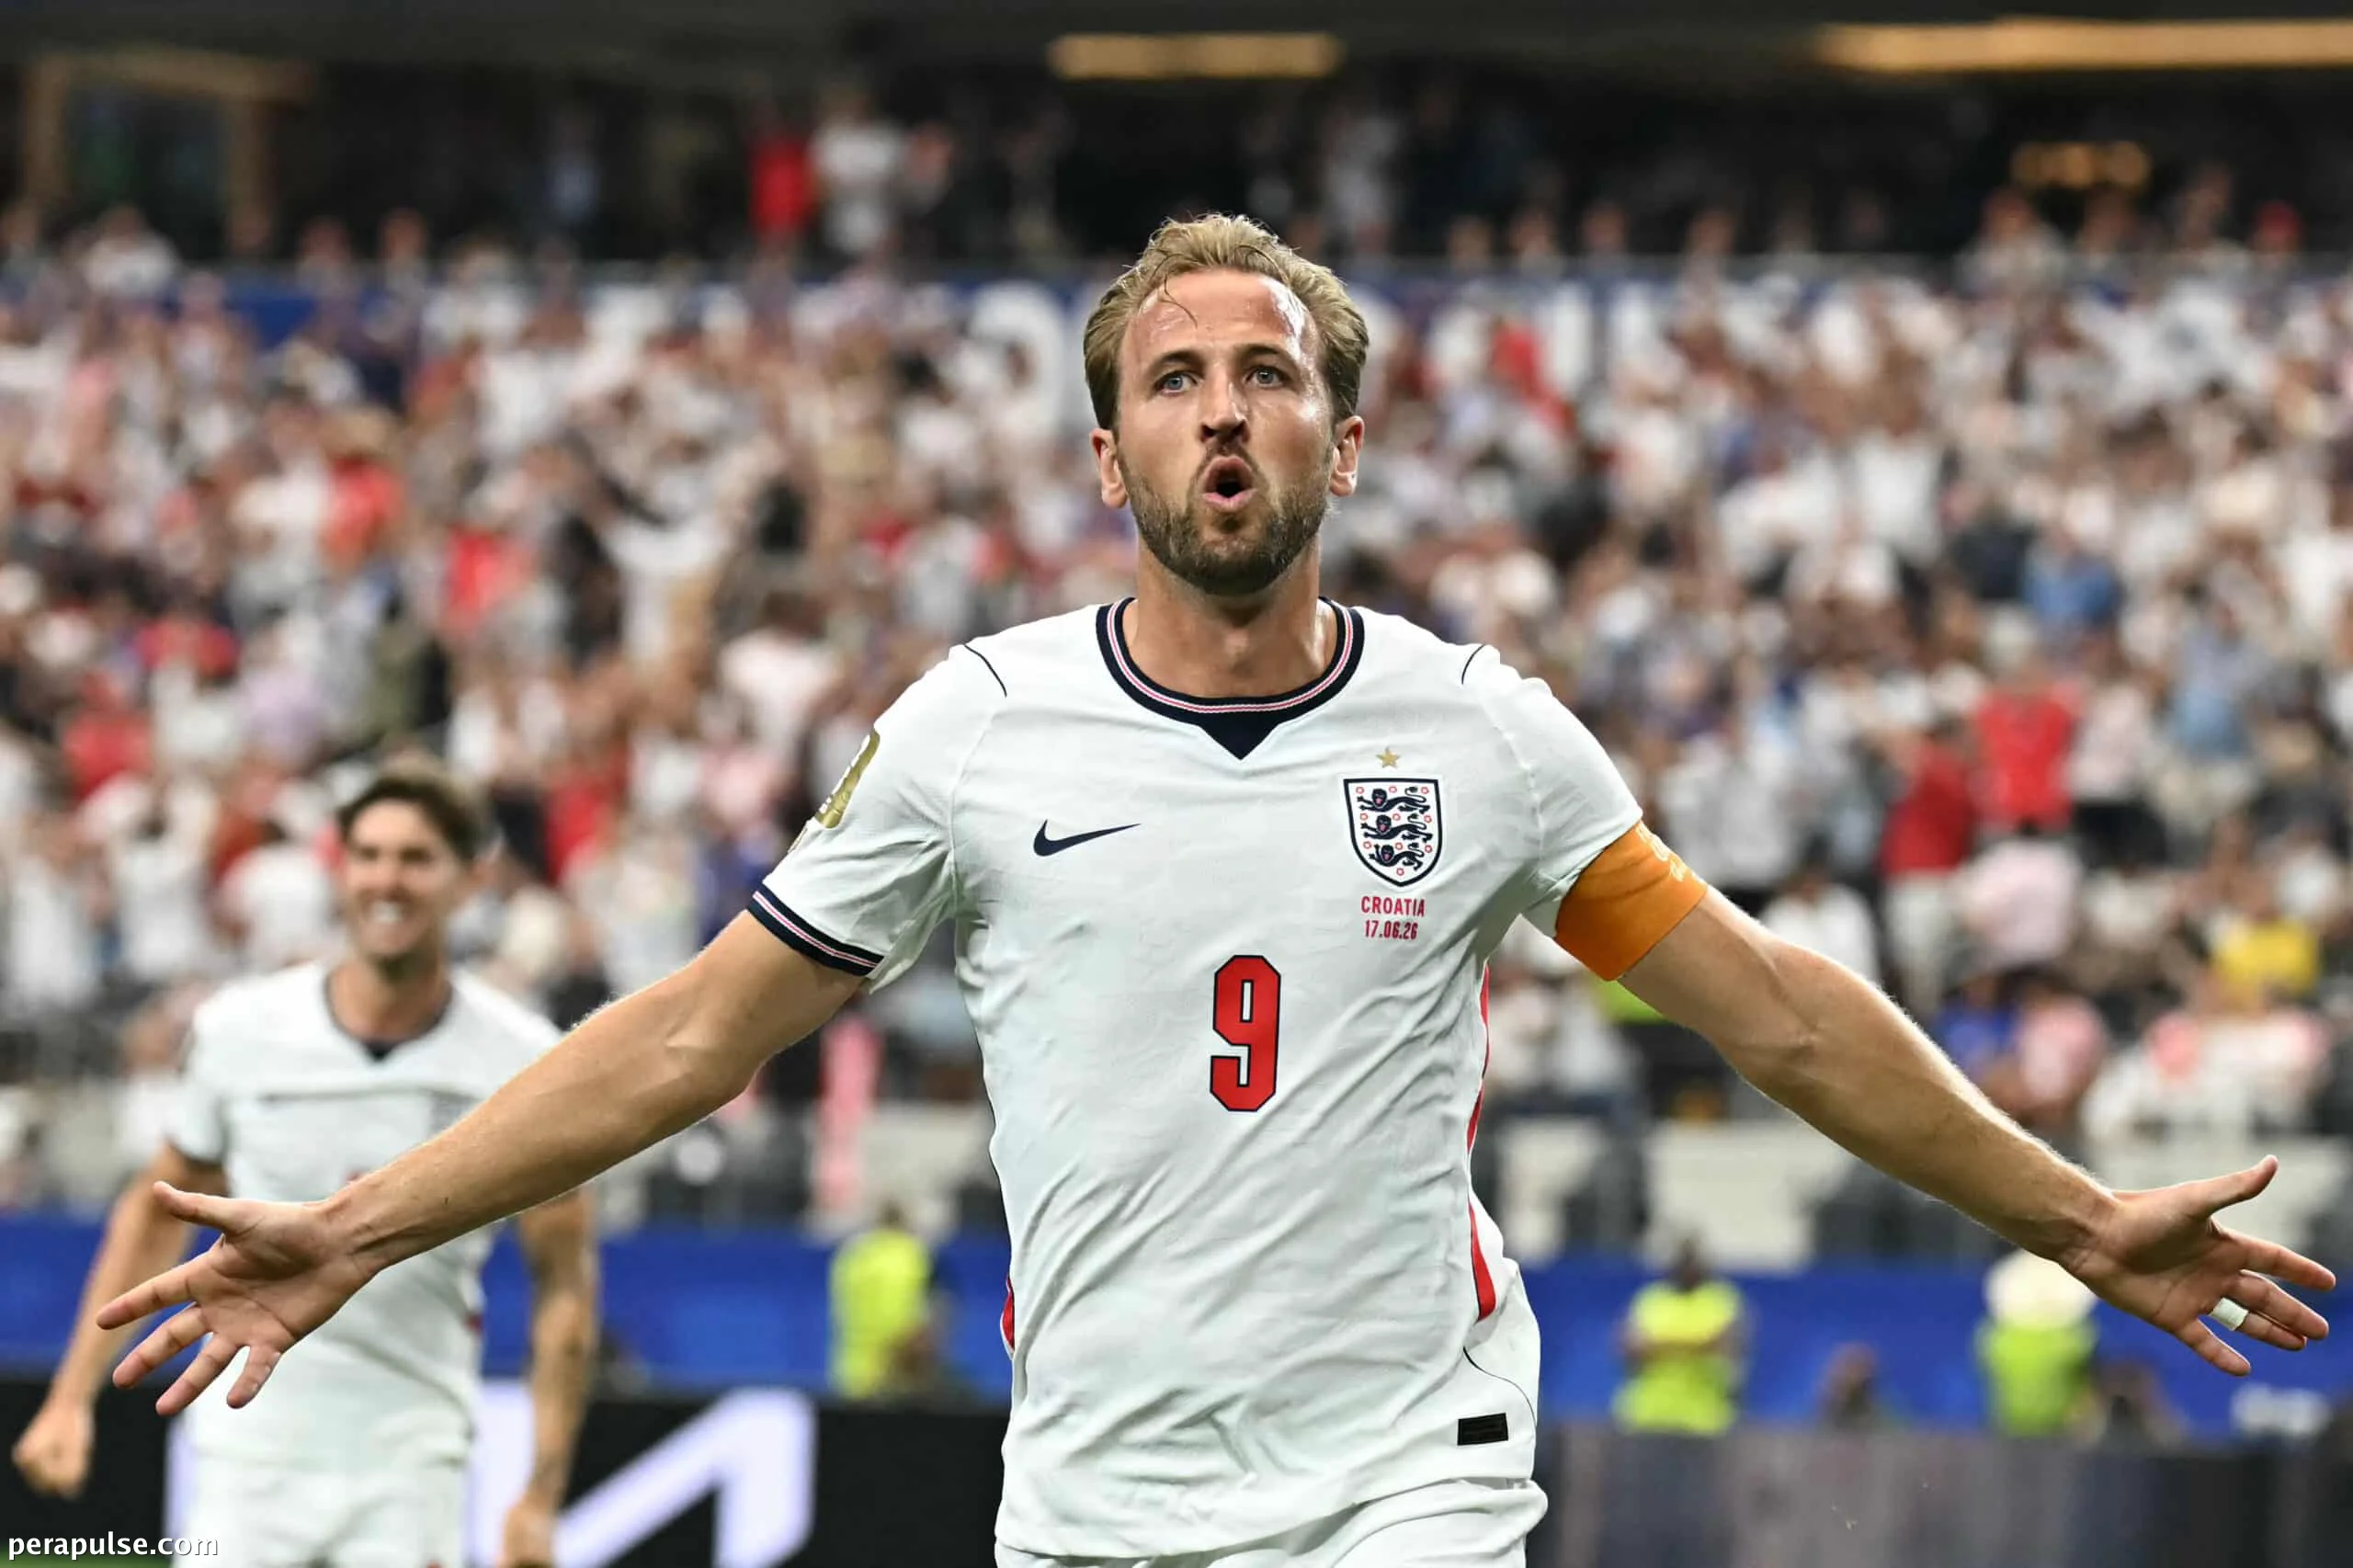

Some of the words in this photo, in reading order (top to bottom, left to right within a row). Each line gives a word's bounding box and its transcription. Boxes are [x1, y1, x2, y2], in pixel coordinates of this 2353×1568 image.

[1360, 895, 1426, 917] CROATIA
[1365, 919, 1419, 940] 17.06.26
[1210, 954, 1281, 1112] 9
